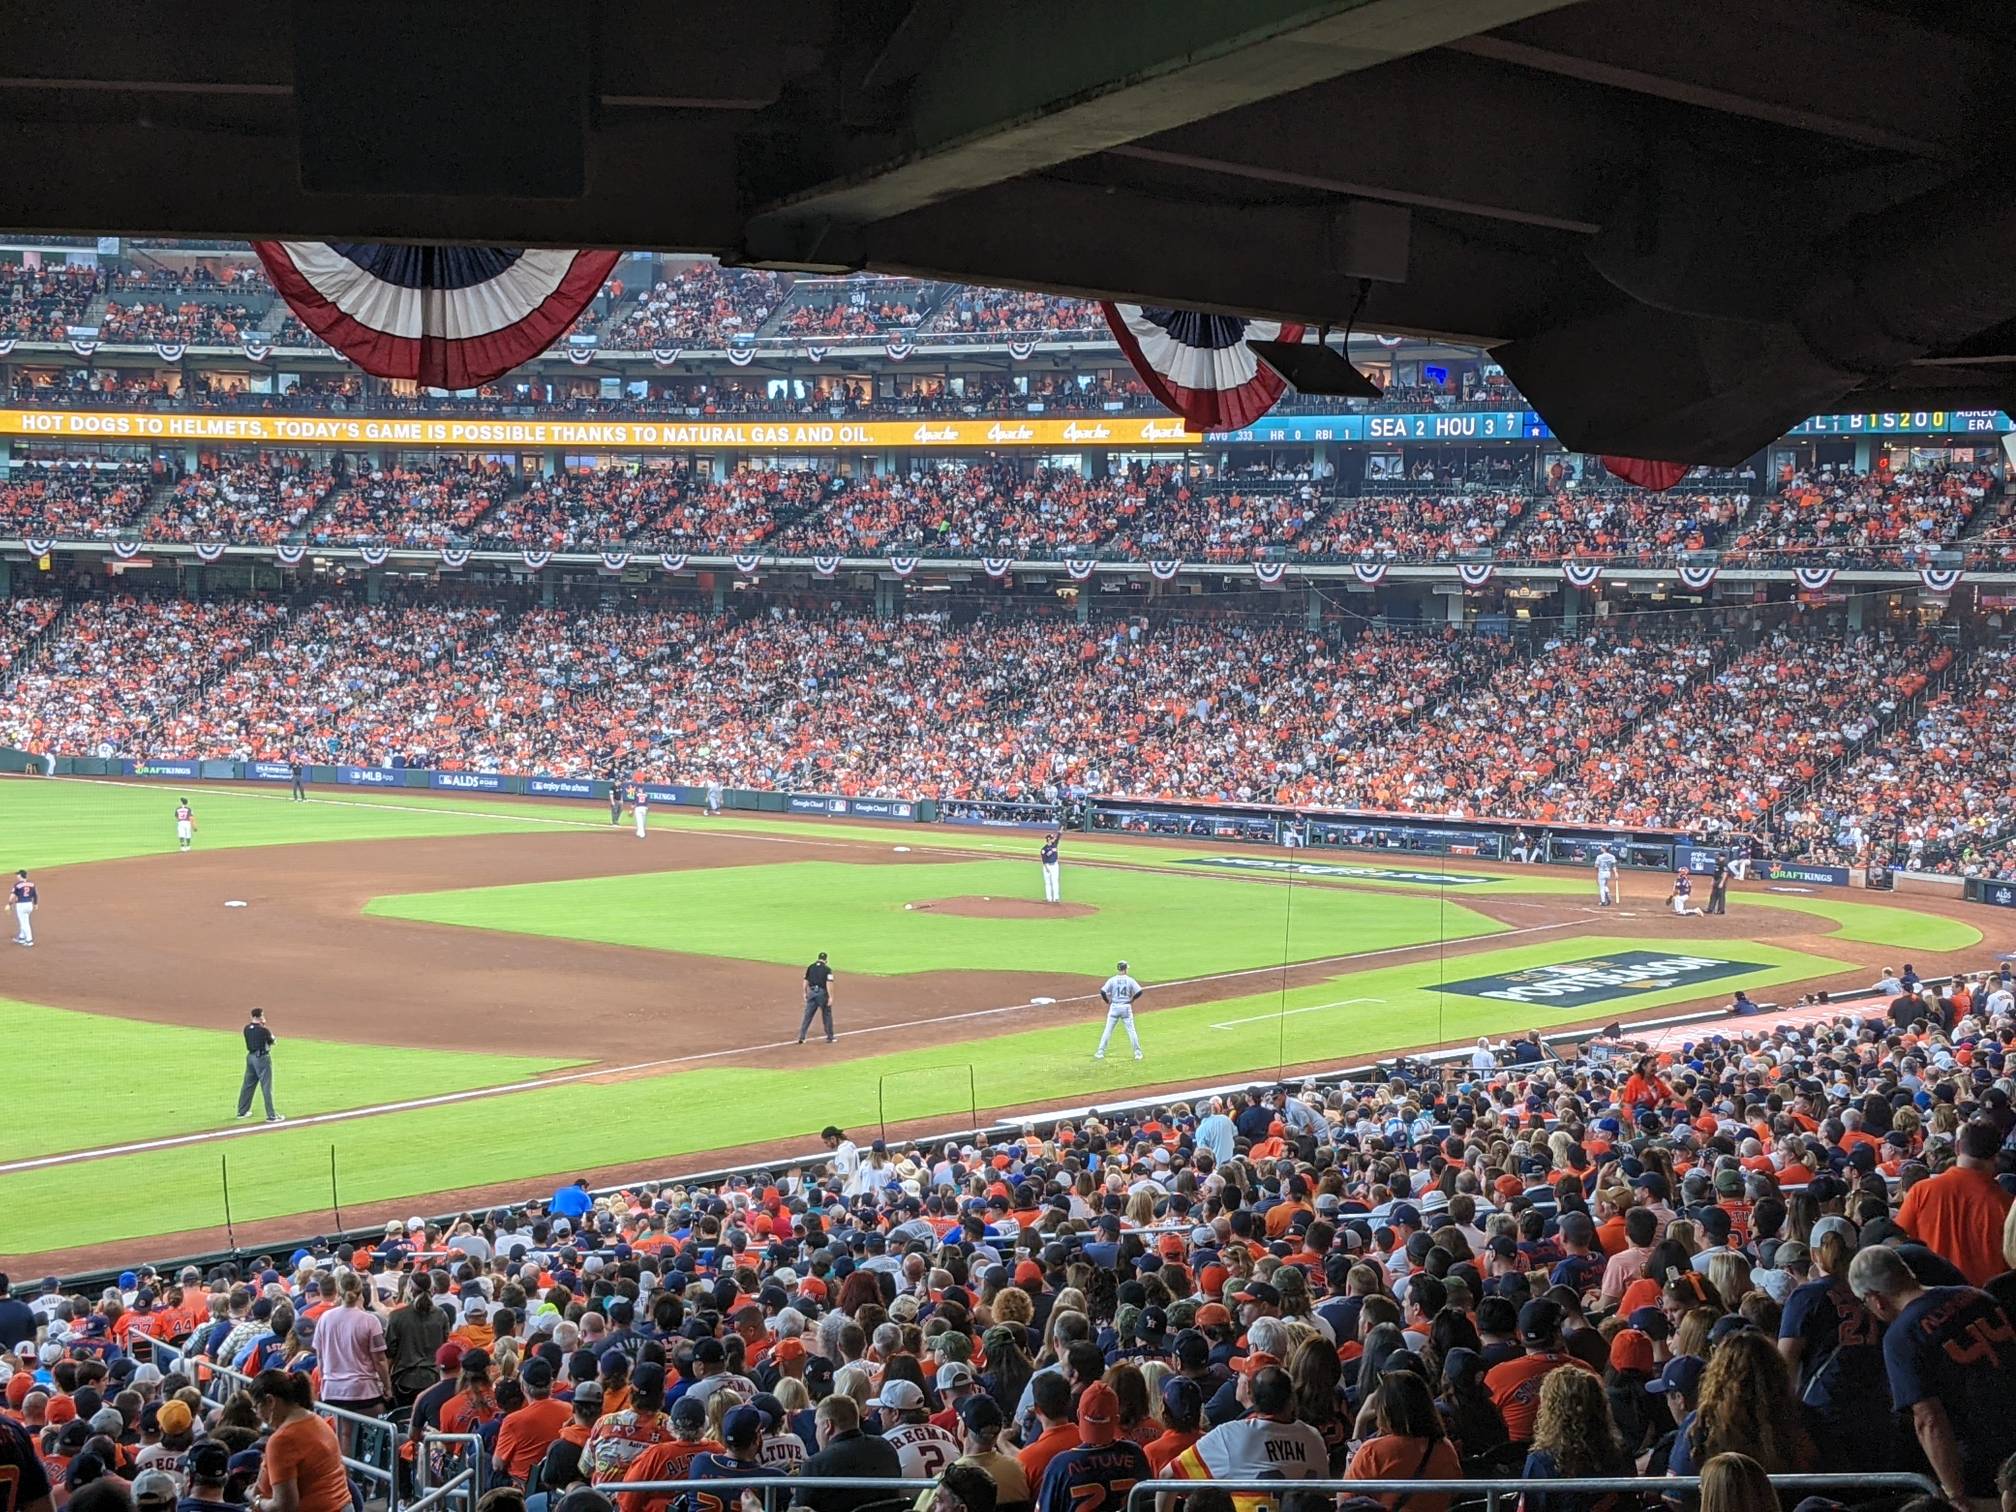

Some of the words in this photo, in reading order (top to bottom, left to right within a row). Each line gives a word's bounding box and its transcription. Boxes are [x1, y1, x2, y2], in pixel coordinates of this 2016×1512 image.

[1370, 417, 1407, 437] SEA
[1415, 421, 1425, 436] 2
[1435, 416, 1475, 436] HOU
[1484, 419, 1493, 434] 3
[1506, 420, 1513, 431] 7
[1883, 413, 1894, 428] S
[1900, 412, 1909, 428] 2
[1968, 419, 1993, 430] ERA
[22, 415, 62, 431] HOT
[71, 415, 130, 432] DOGS
[136, 417, 163, 433] TO
[170, 418, 267, 437] HELMETS,
[275, 421, 360, 438] TODAY'S
[366, 422, 421, 439] GAME
[428, 424, 446, 439] IS
[453, 425, 545, 441] POSSIBLE
[552, 426, 626, 442] THANKS
[633, 427, 657, 442] TO
[663, 427, 745, 442] NATURAL
[751, 427, 789, 442] GAS
[796, 427, 833, 442] AND
[840, 426, 873, 442] OIL.
[914, 423, 959, 442] Apache
[987, 423, 1033, 441] Apache
[1063, 421, 1110, 441] Apache
[1209, 431, 1228, 441] AVG
[1236, 430, 1253, 441] .333
[1270, 430, 1285, 441] HR
[1294, 429, 1301, 441] 0
[1315, 430, 1332, 440] RBI
[135, 766, 191, 776] DRAFTKINGS
[362, 770, 382, 782] MLB
[452, 775, 479, 787] ALDS
[543, 782, 560, 791] enjoy
[560, 783, 572, 791] the
[792, 799, 810, 808] Google
[810, 800, 824, 808] Cloud
[855, 803, 873, 812] Google
[874, 804, 887, 812] Cloud
[1769, 869, 1833, 883] DRAFTKINGS
[23, 886, 31, 897] 2
[1117, 985, 1127, 997] 14
[173, 1318, 193, 1333] 44
[760, 1443, 801, 1464] LTUVE
[1264, 1439, 1306, 1463] RYAN
[918, 1445, 946, 1479] 2
[1068, 1453, 1136, 1477] ALTUVE
